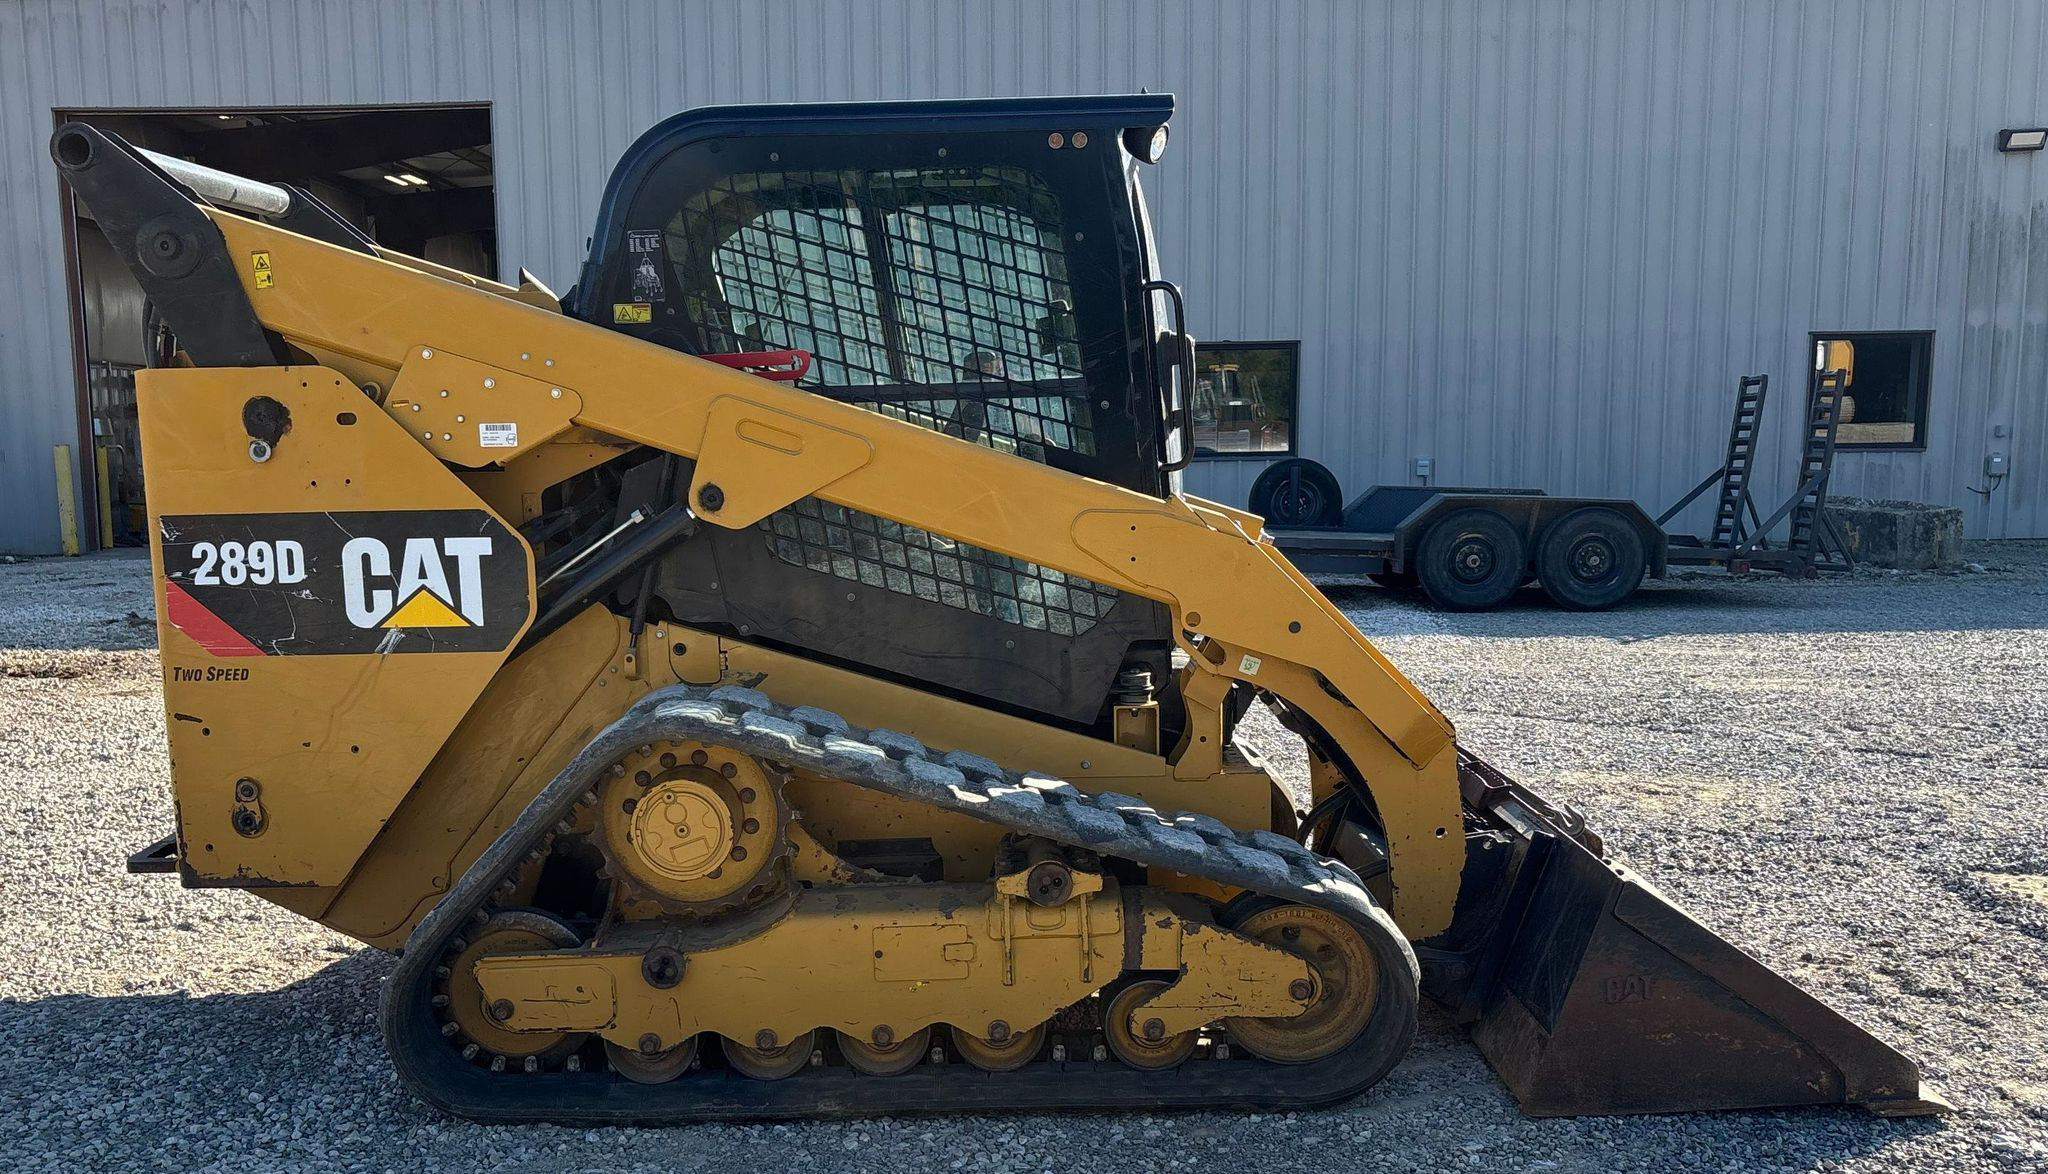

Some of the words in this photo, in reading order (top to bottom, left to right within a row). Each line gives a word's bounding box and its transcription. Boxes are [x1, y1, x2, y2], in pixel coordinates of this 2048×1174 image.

[191, 540, 306, 586] 289D
[341, 537, 493, 628] CAT
[1603, 975, 1655, 1004] CAT
